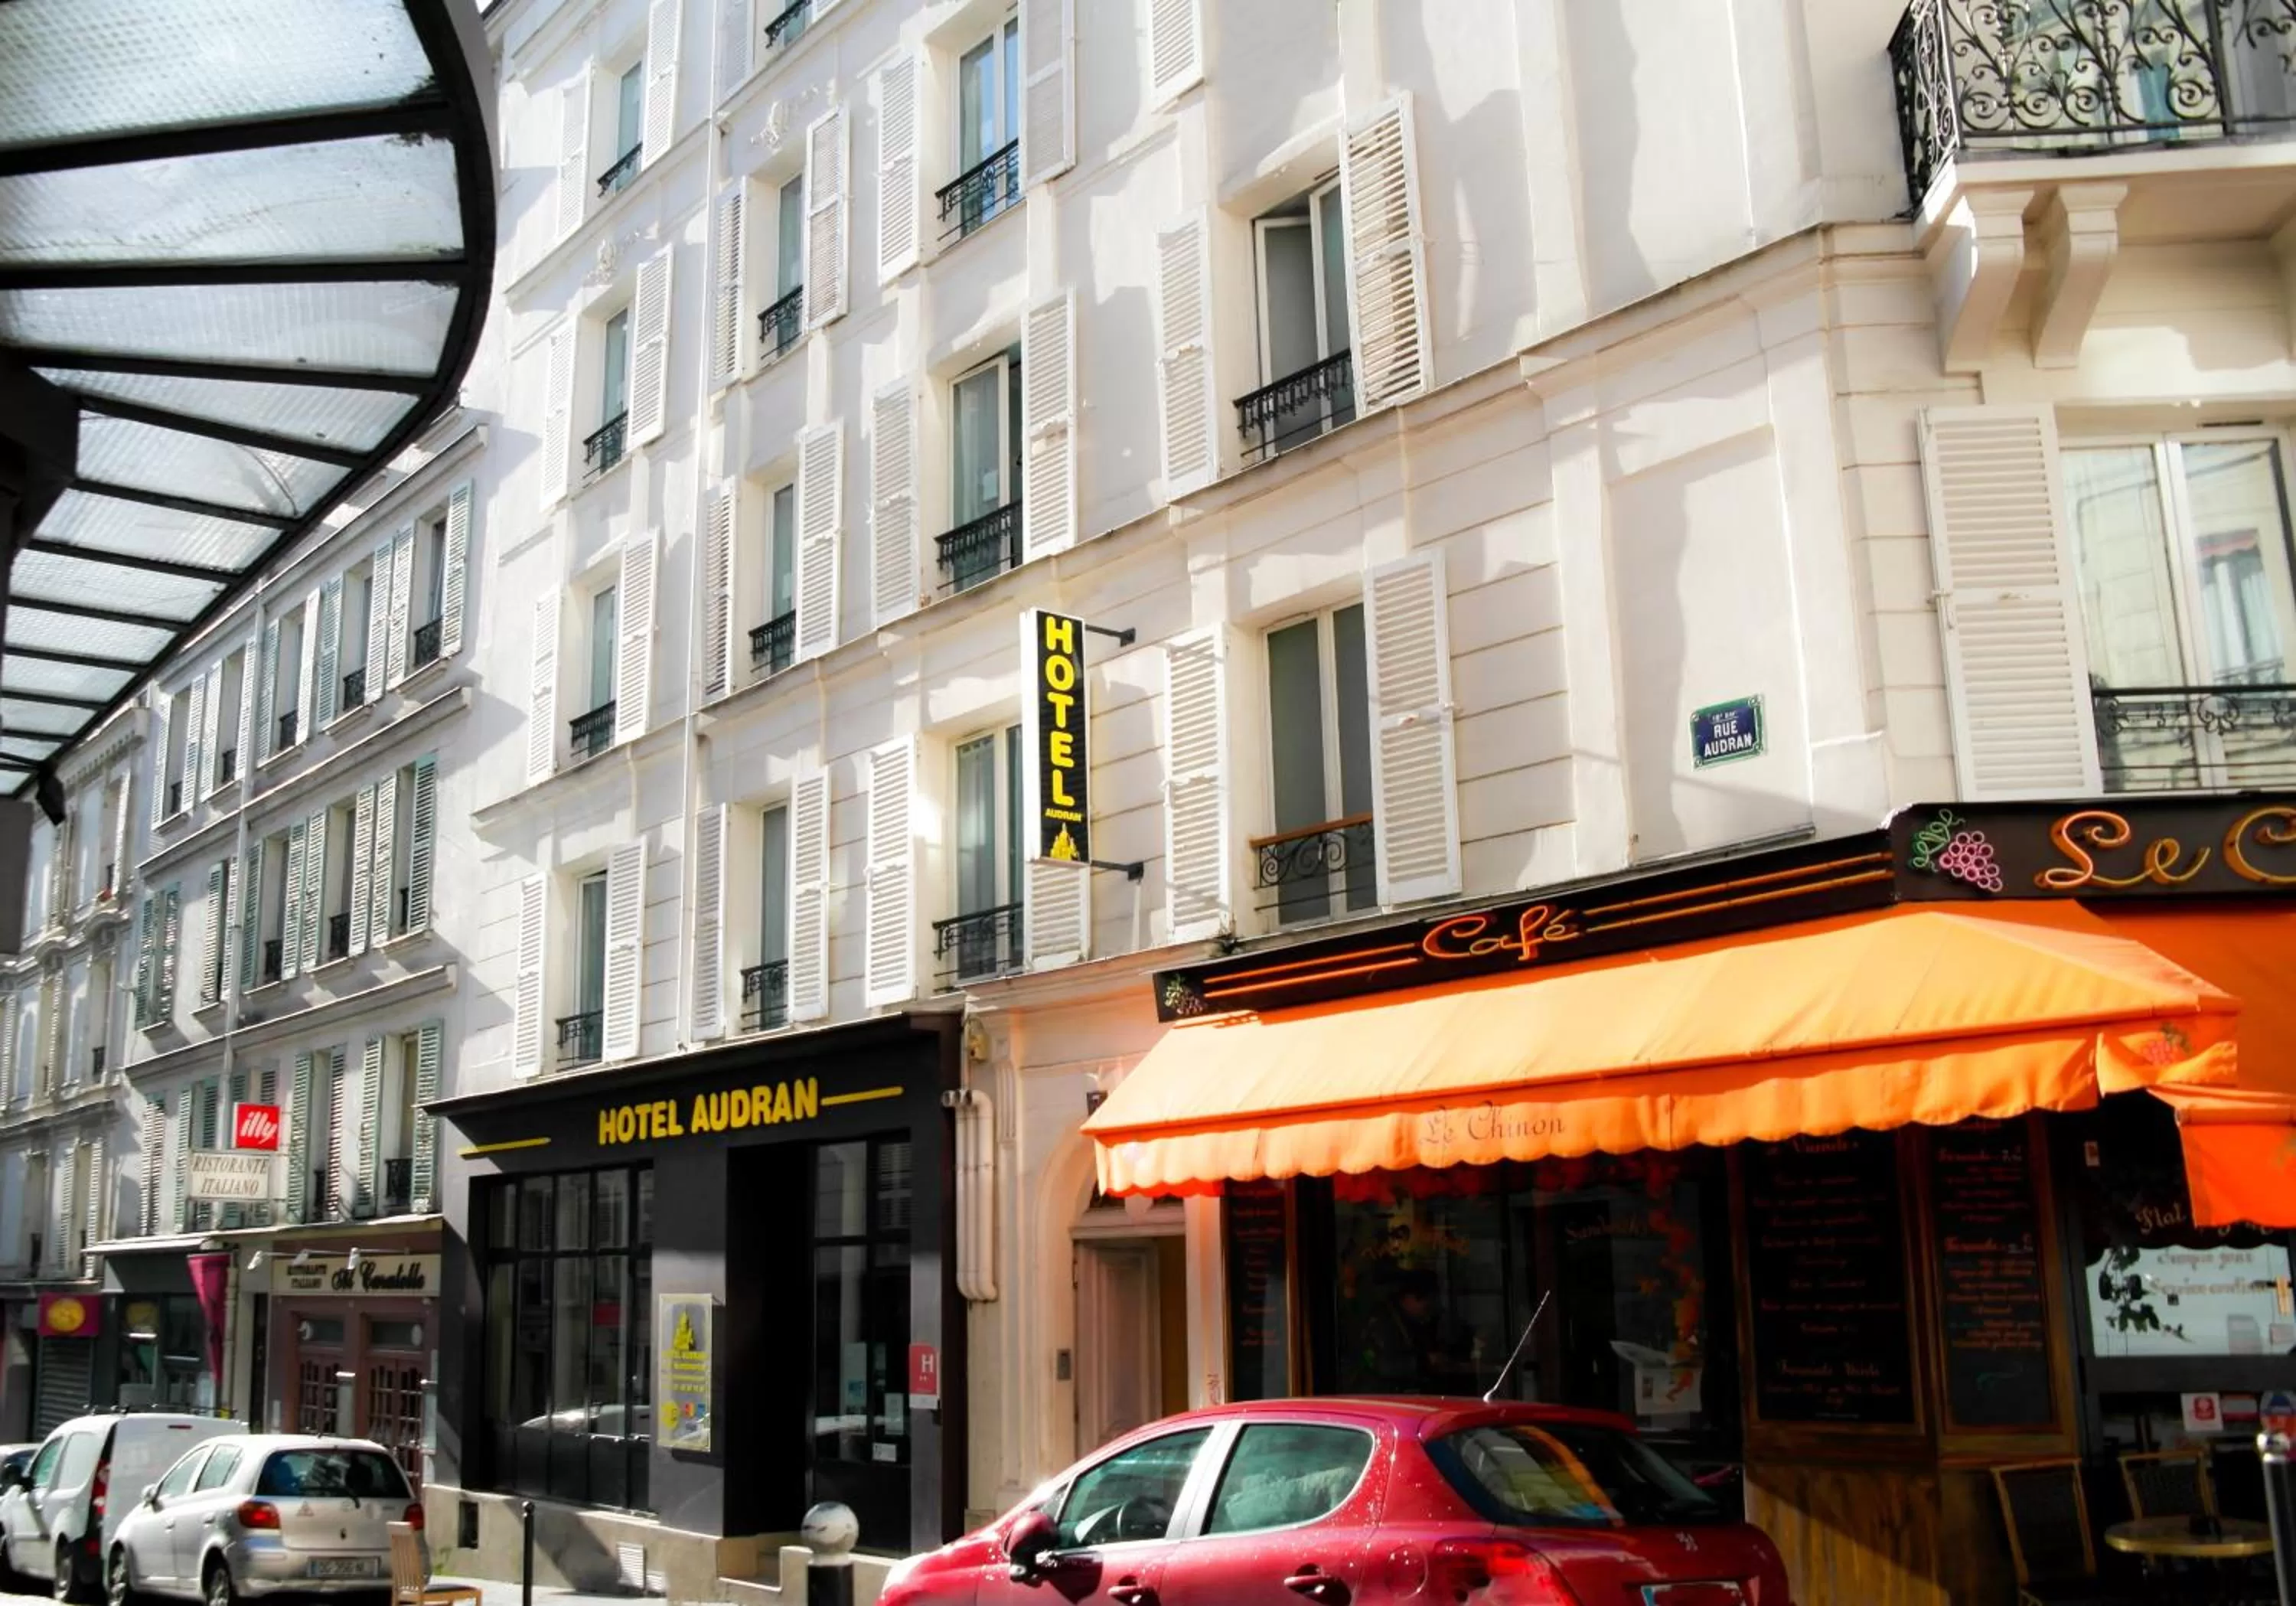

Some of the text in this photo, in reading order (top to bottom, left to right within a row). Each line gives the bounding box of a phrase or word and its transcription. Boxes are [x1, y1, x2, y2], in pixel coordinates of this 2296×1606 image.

[1045, 615, 1075, 807] HOTEL
[1704, 732, 1753, 758] AUDRAN
[1714, 720, 1738, 738] RUE
[2033, 809, 2210, 890] Le
[1422, 905, 1583, 961] Café
[240, 1111, 278, 1145] illy
[598, 1076, 818, 1146] HOTEL AUDRAN
[1418, 1099, 1567, 1145] Le Chinon
[192, 1156, 268, 1174] RISTORANTE
[201, 1178, 259, 1196] ITALIANO
[921, 1353, 934, 1373] H
